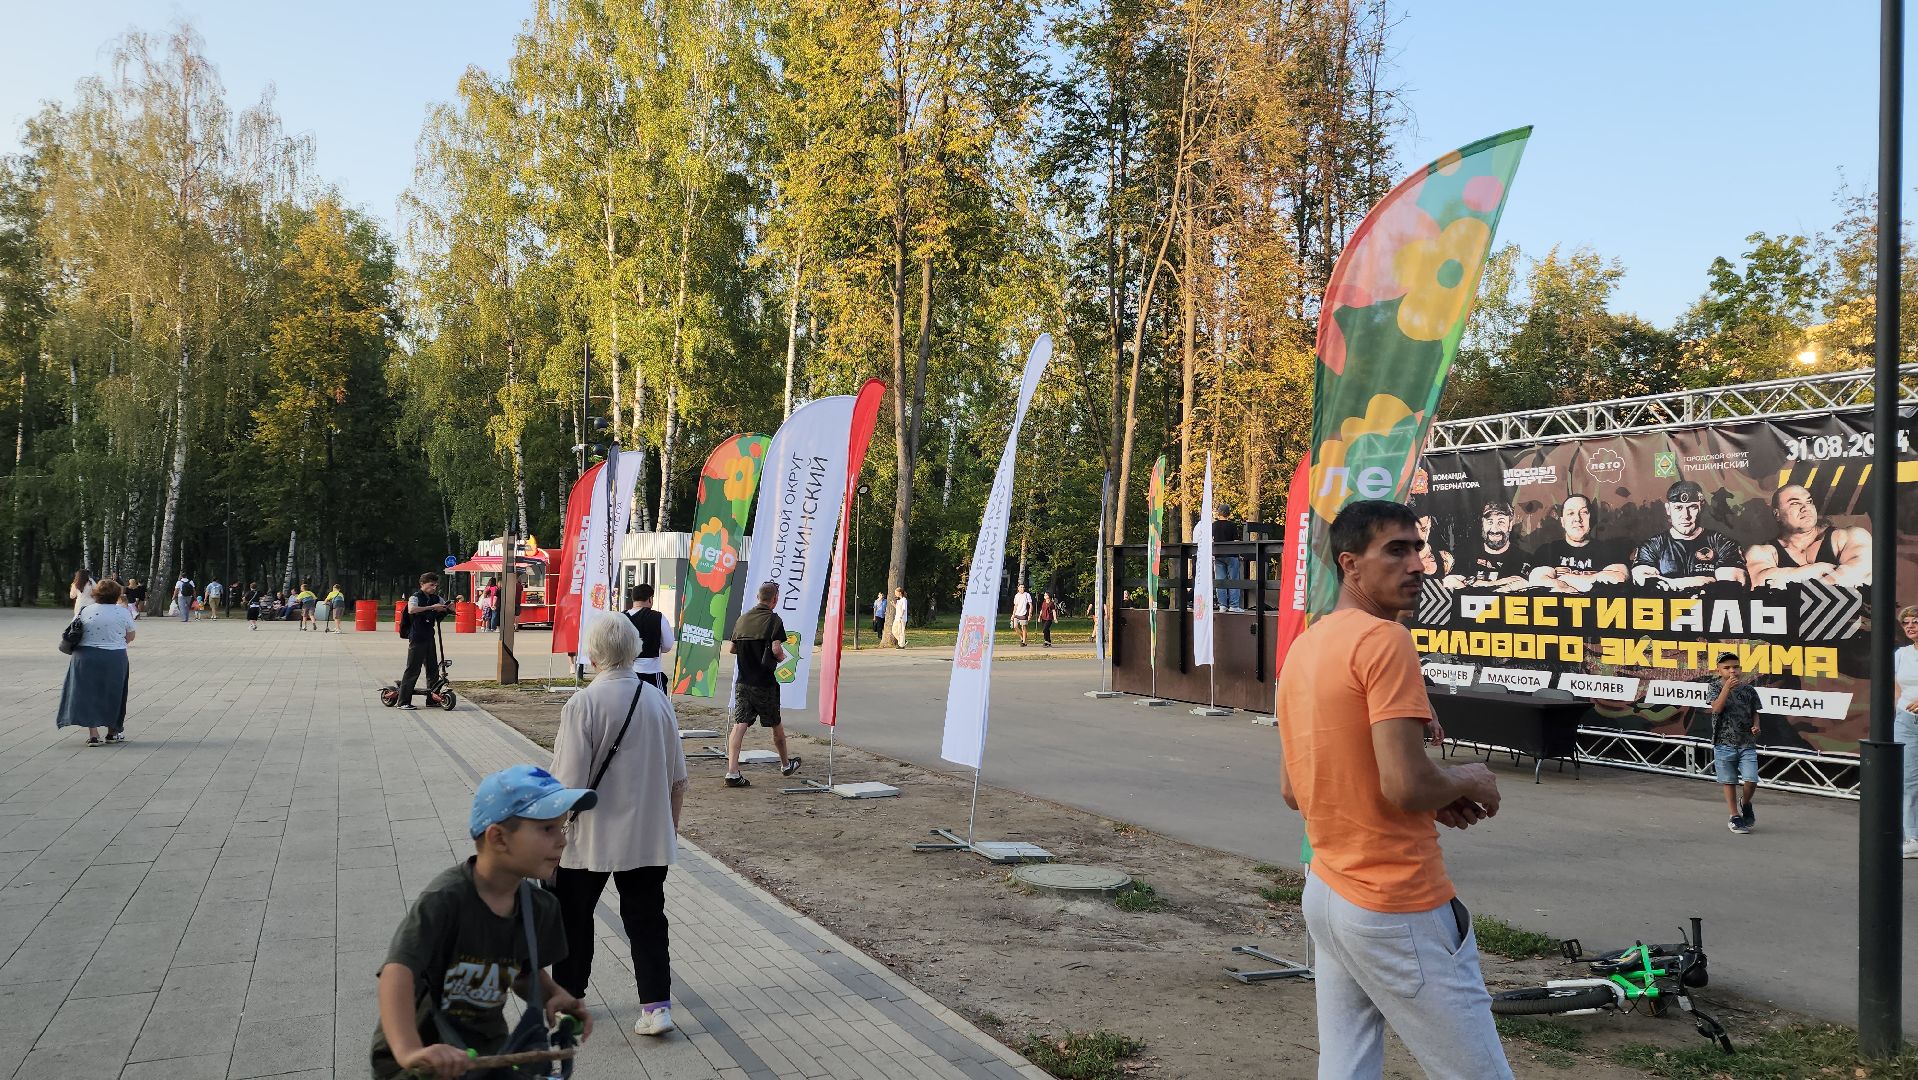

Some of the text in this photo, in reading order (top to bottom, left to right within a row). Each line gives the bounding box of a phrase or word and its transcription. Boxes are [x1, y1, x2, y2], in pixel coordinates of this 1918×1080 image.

[1785, 429, 1910, 461] 31.08.204
[1683, 451, 1750, 463] ГОРОДСКОЙ ОКРУГ
[1503, 465, 1556, 479] МОСОБЛ
[1683, 459, 1749, 472] ПУШКИНСКИЙ
[785, 451, 804, 505] ОКРУГ
[1432, 471, 1468, 482] КОМАНДА
[1503, 475, 1552, 487] СПОРТ
[1432, 481, 1481, 492] ГУБЕРНАТОРА
[783, 456, 829, 611] ПУШКИНСКИЙ
[1460, 594, 1788, 635] ФЕСТИВАЛЬ
[1410, 628, 1584, 663] СИЛОВОГО
[1487, 673, 1541, 687] МАКСЮТА
[1570, 679, 1625, 694] КОКЛЯЕВ
[1770, 695, 1824, 710] ПЕДАН
